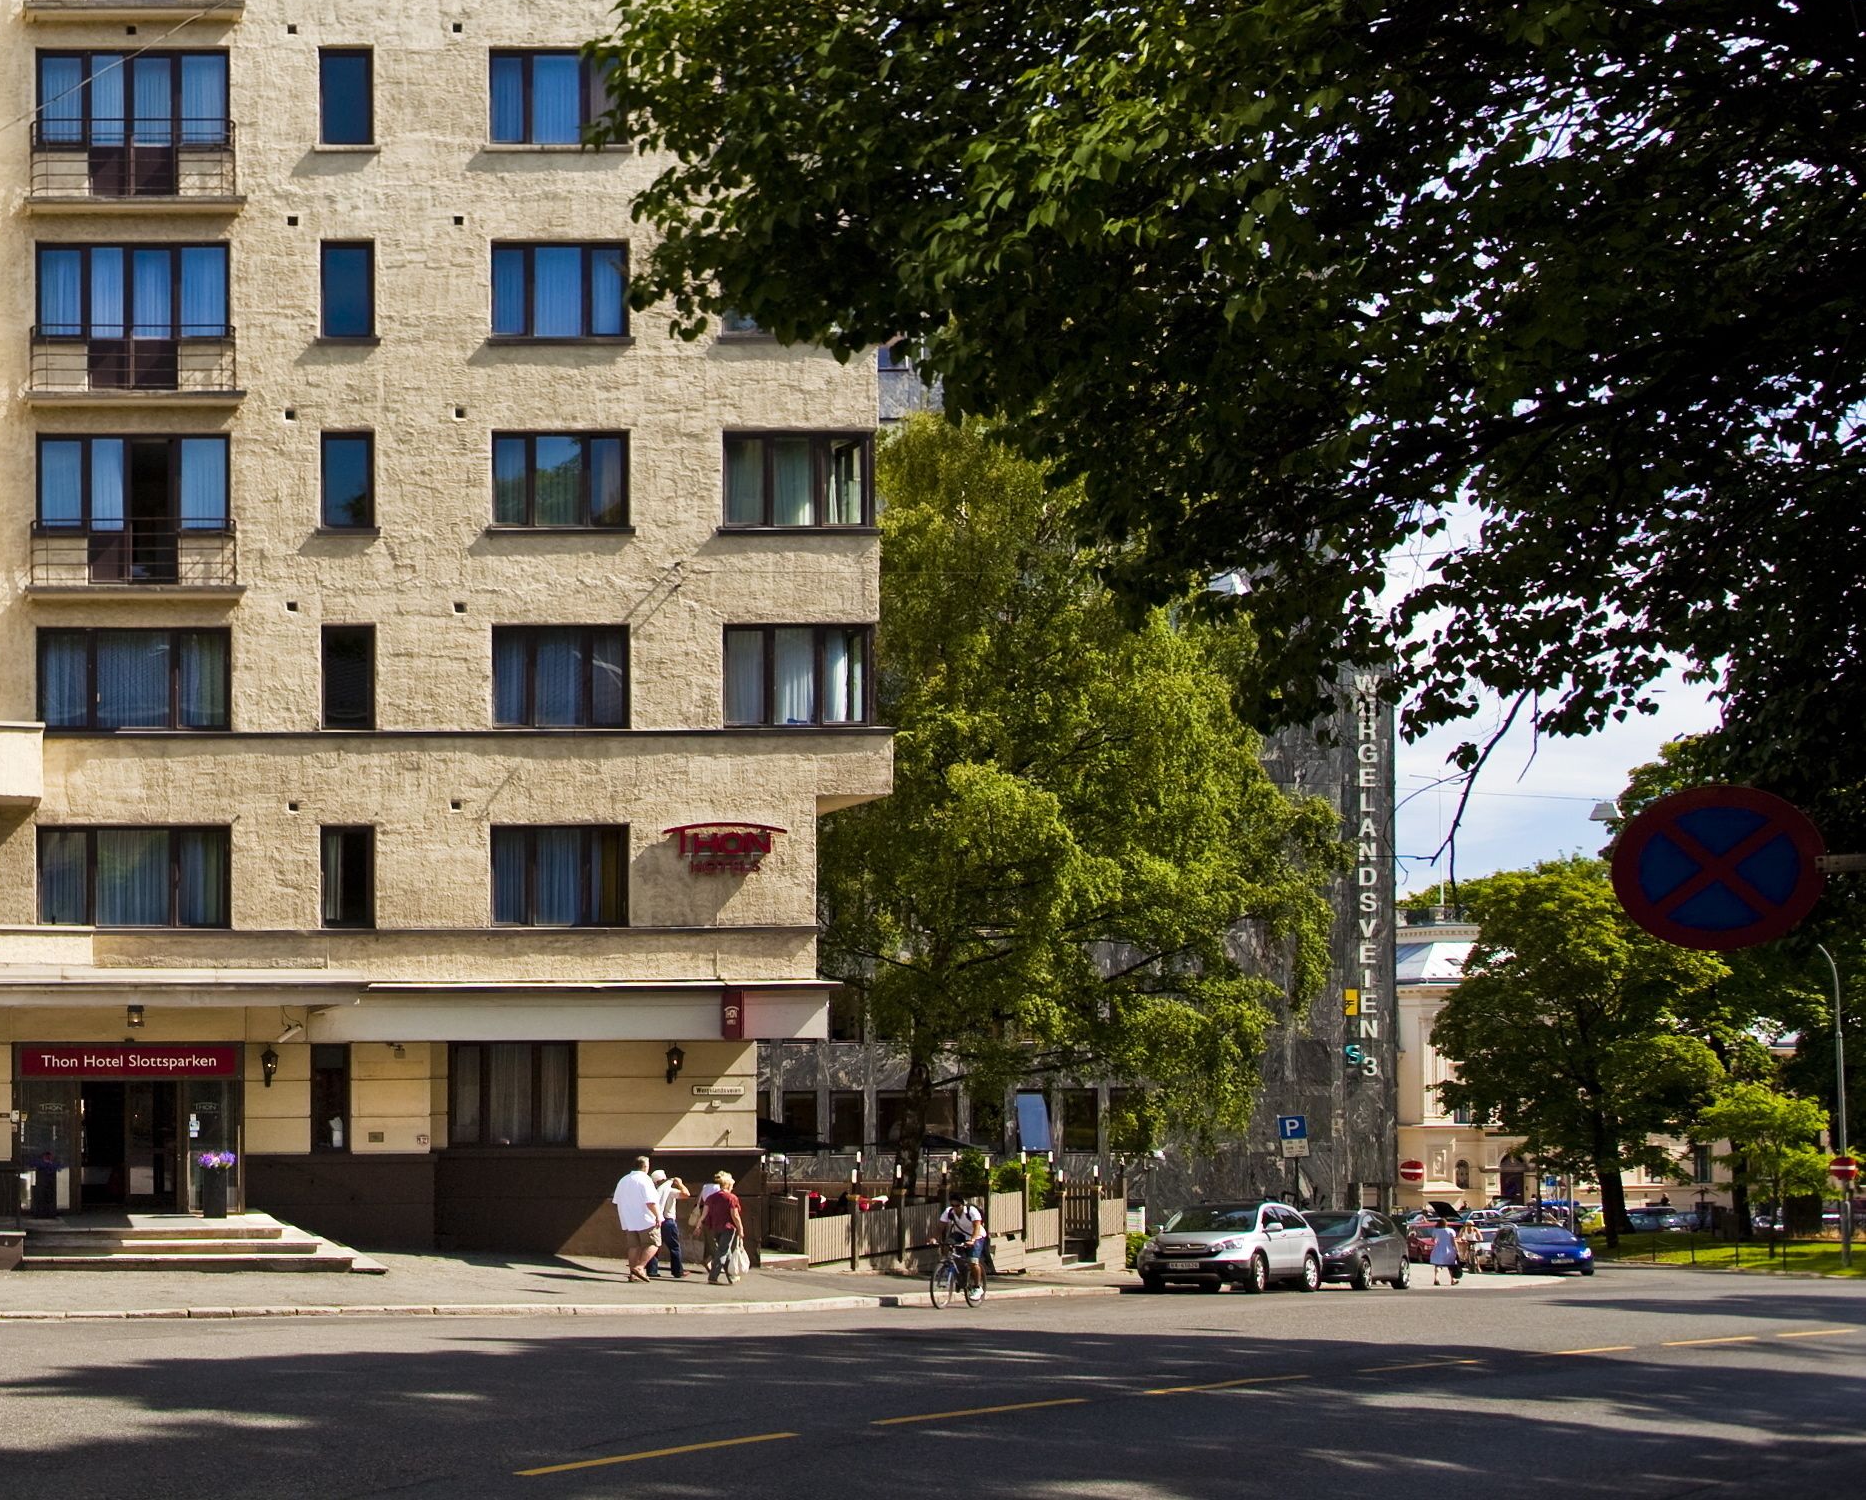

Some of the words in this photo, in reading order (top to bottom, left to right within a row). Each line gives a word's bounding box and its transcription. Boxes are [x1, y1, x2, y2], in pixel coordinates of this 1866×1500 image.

[663, 822, 787, 854] THON
[41, 1054, 79, 1068] Thon
[83, 1054, 124, 1068] Hotel
[128, 1054, 217, 1071] Slottsparken
[1362, 1056, 1378, 1077] 3
[1285, 1119, 1299, 1137] P
